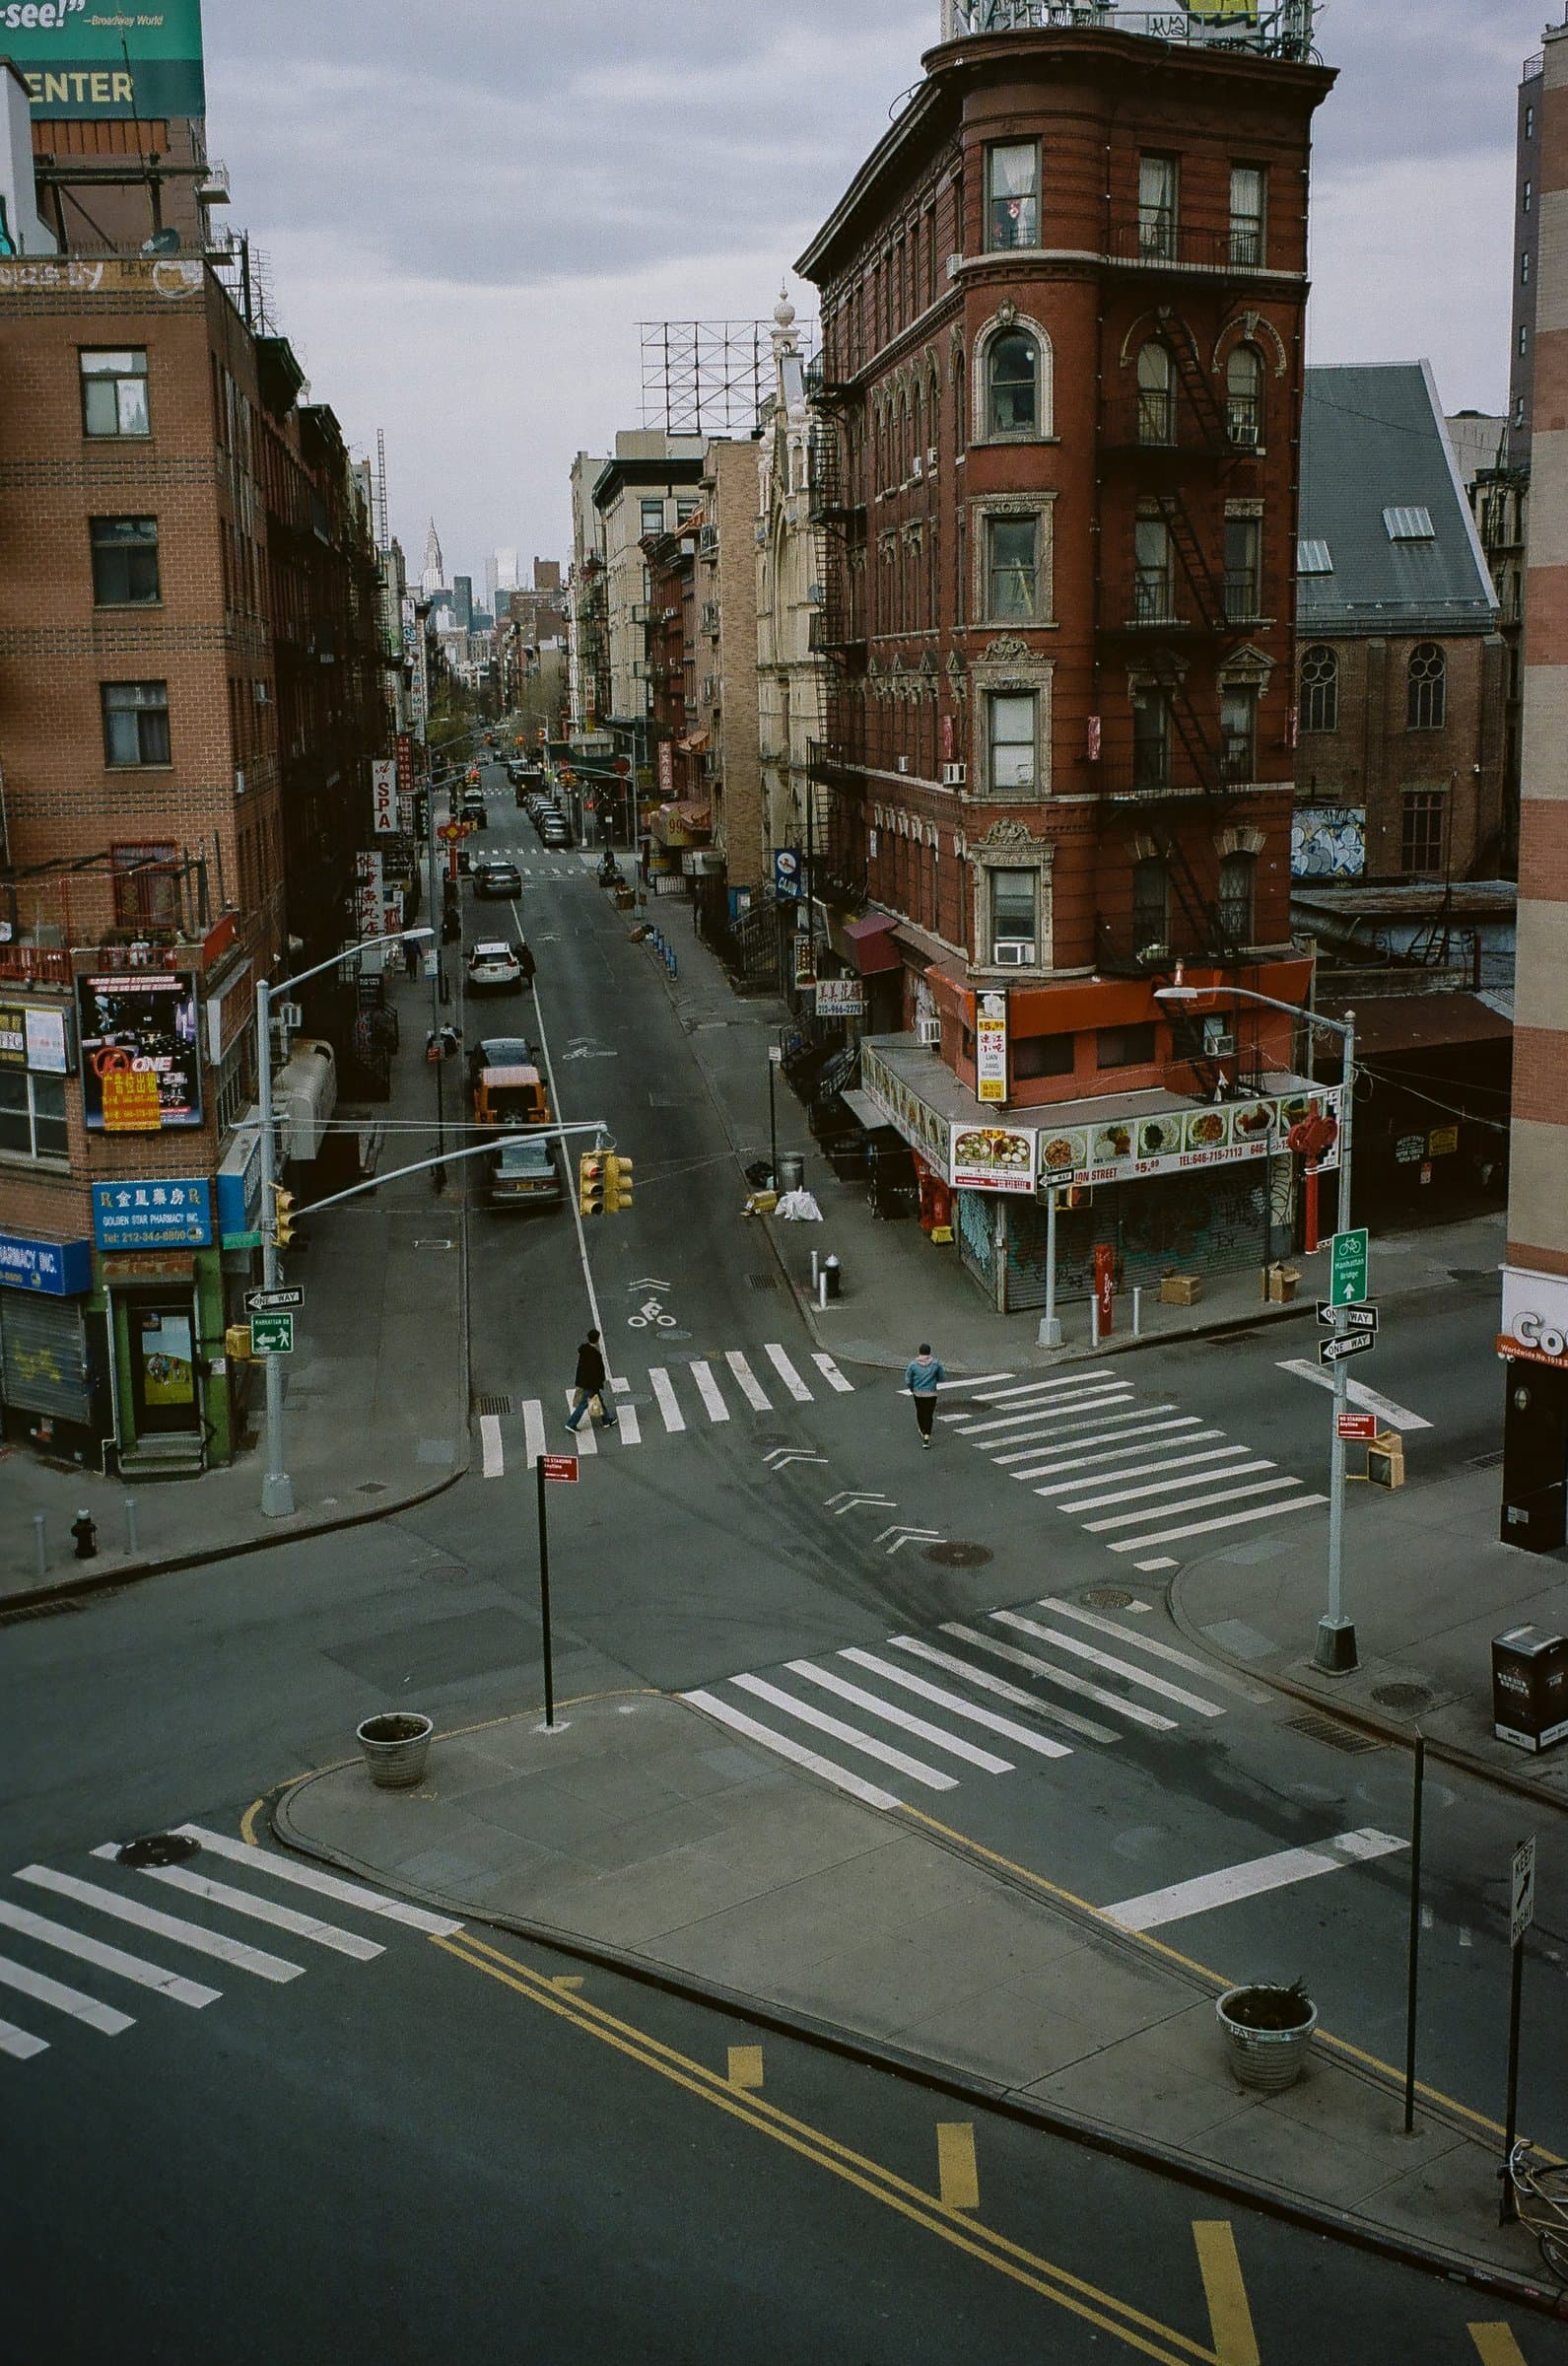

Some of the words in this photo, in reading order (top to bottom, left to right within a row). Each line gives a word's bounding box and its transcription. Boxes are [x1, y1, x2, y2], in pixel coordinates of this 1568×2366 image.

[137, 16, 163, 26] World
[377, 782, 390, 828] SPA
[778, 876, 798, 896] CAJUN
[132, 1057, 171, 1073] ONE
[1091, 1167, 1118, 1181] STREET
[1134, 1159, 1160, 1173] $5.99
[102, 1216, 129, 1226] GOLDEN
[131, 1215, 148, 1224] STAR
[150, 1214, 183, 1224] PHARMACY
[103, 1233, 118, 1243] Tel:
[1335, 1259, 1364, 1270] Manhattan
[1340, 1271, 1359, 1280] Bridge
[1349, 1312, 1369, 1322] WAY
[1329, 1344, 1343, 1355] ONE
[1351, 1336, 1367, 1349] WAY
[1501, 1345, 1534, 1358] Worldwide
